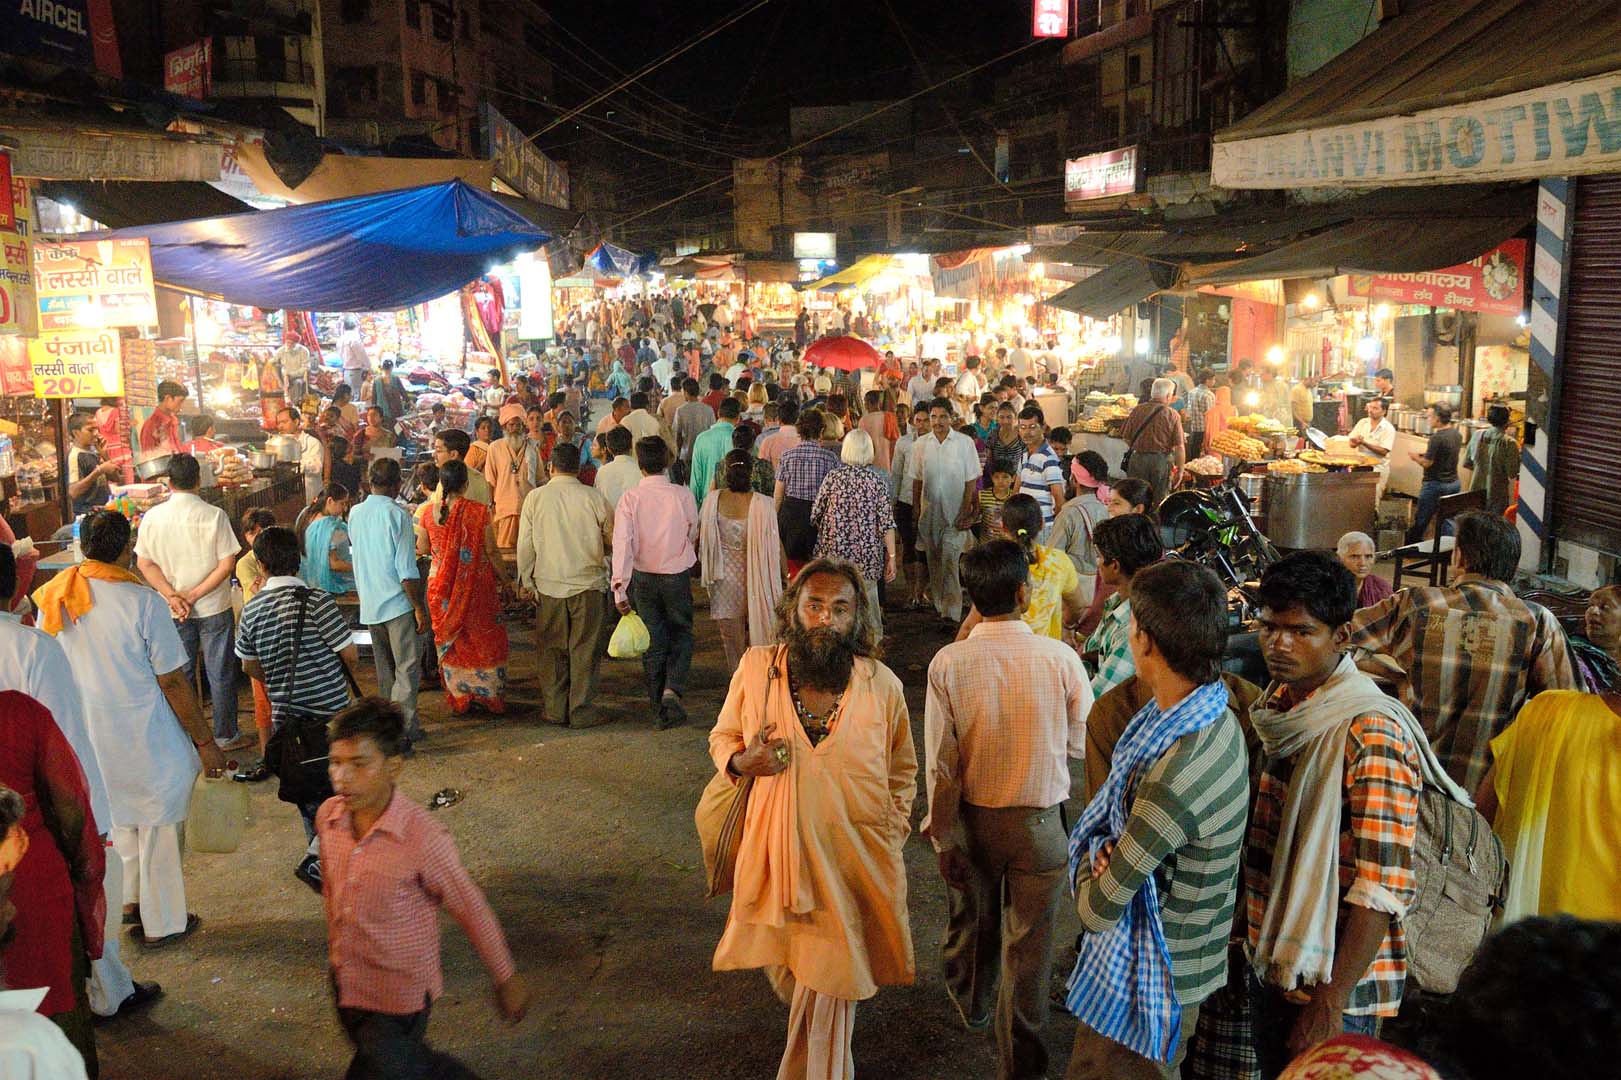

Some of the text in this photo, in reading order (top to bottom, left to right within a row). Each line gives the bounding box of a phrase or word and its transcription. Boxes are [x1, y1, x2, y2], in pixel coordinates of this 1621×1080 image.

[20, 0, 87, 36] AIRCEL
[34, 358, 94, 376] लस्सी वाला
[43, 377, 92, 396] 20/-
